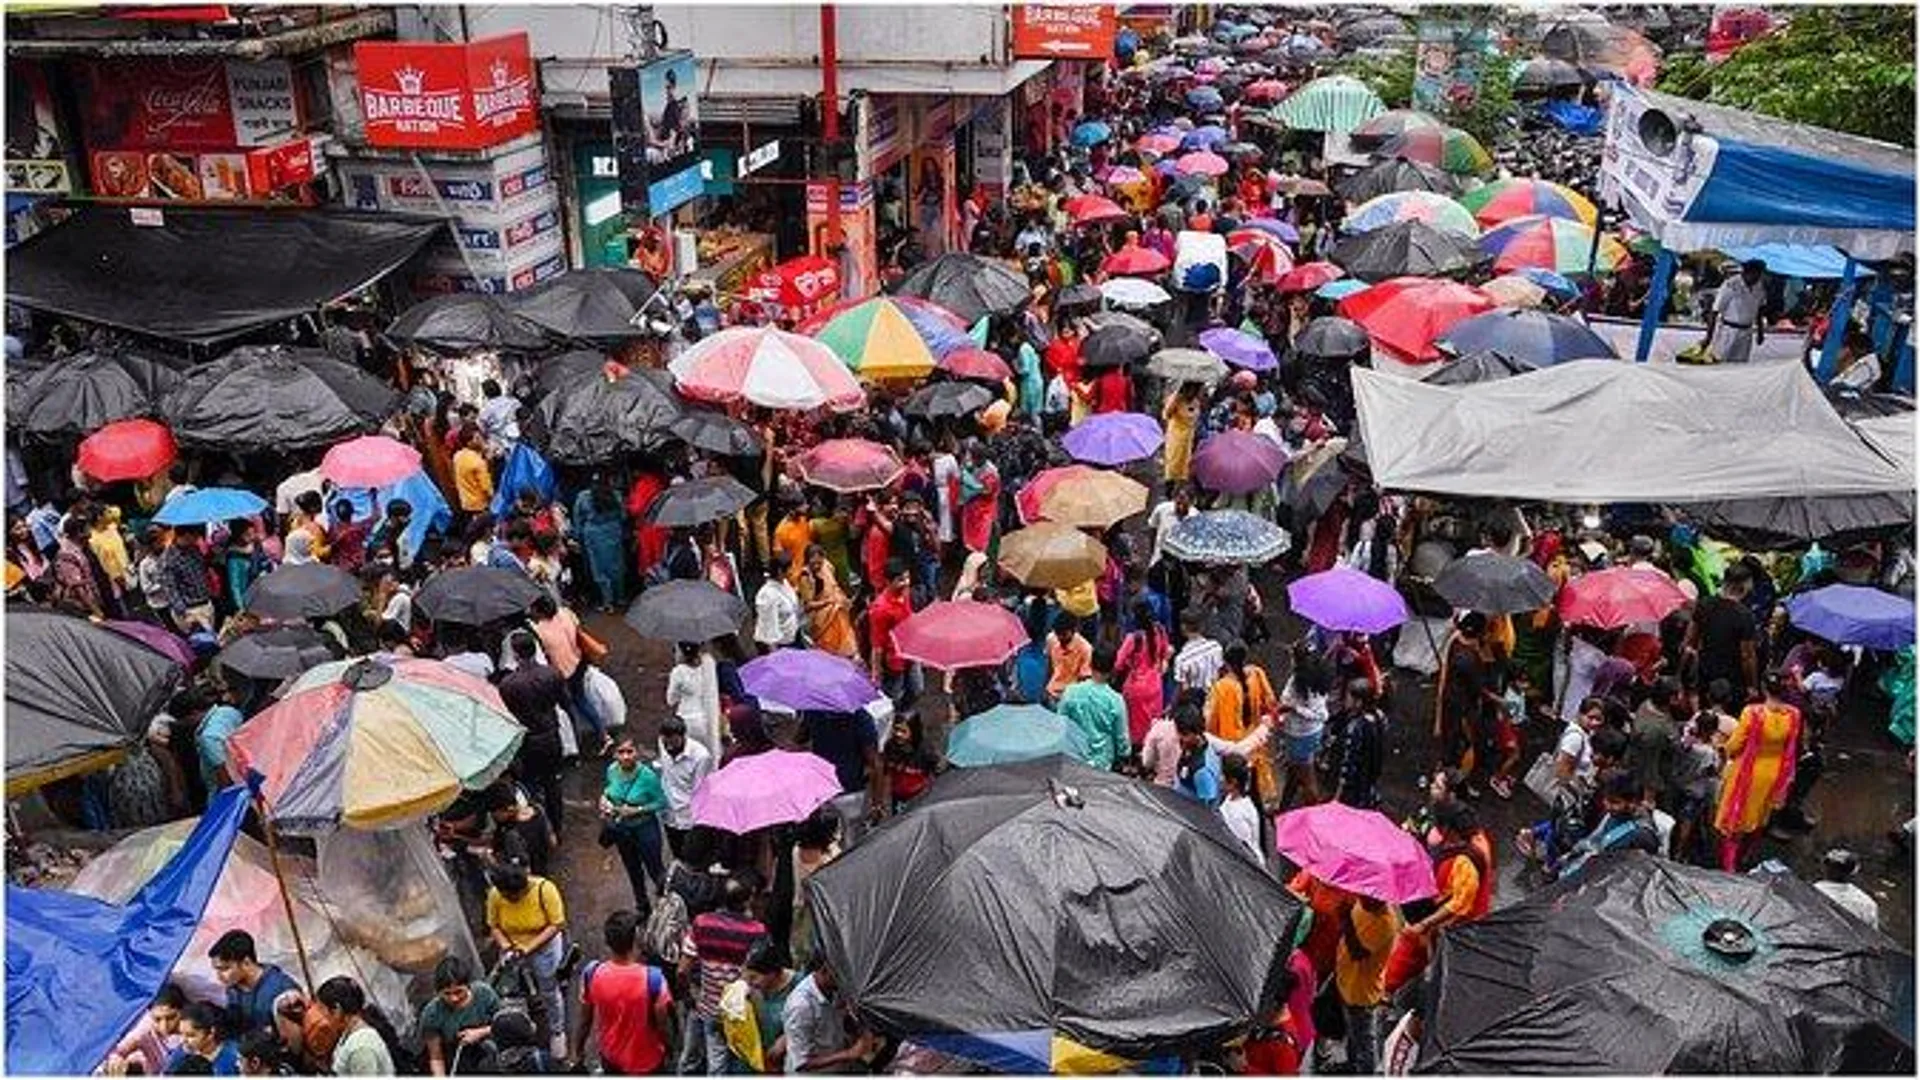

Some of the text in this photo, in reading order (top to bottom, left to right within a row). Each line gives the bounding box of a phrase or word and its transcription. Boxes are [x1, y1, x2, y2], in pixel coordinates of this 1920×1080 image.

[239, 96, 292, 111] SNACKS
[365, 92, 465, 120] BARBEQUE
[396, 120, 439, 132] NATION
